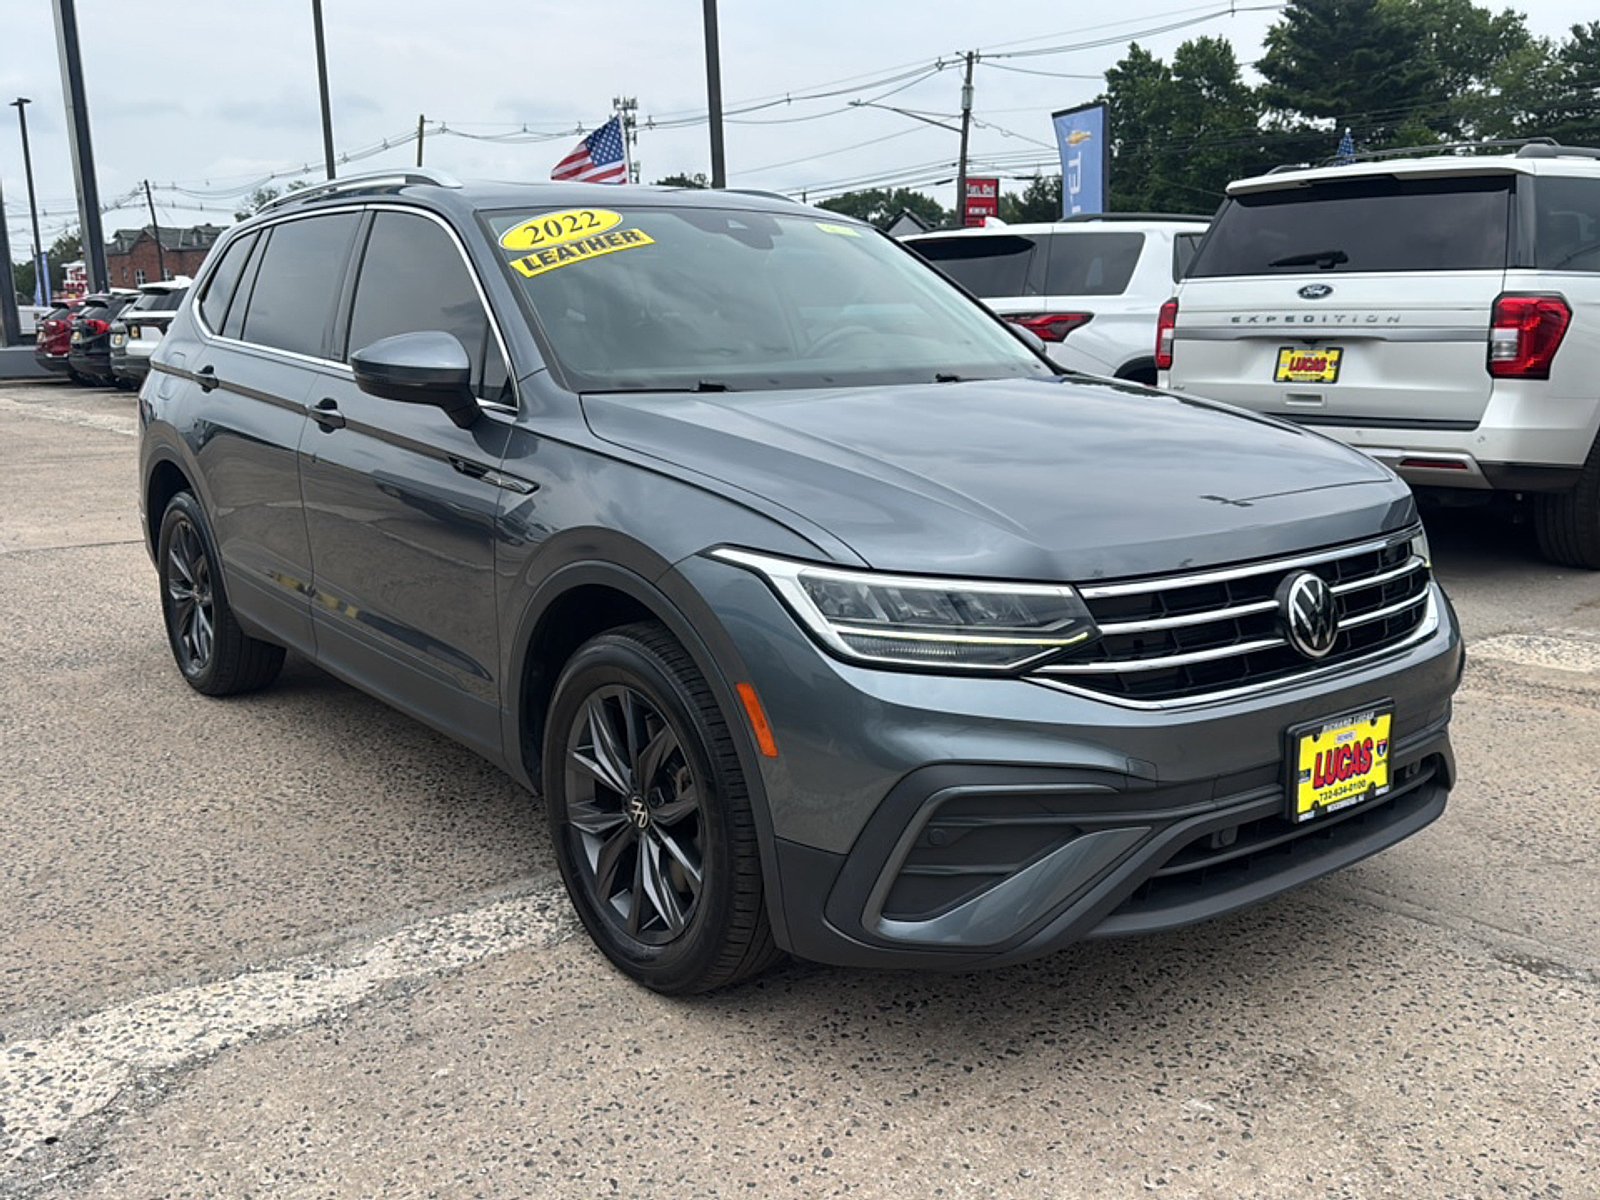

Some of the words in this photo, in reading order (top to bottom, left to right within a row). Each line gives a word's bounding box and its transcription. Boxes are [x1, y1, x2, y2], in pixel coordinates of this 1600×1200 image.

[523, 211, 601, 244] 2022
[521, 231, 641, 271] LEATHER
[1231, 314, 1402, 324] EXPEDITION
[1288, 356, 1329, 374] LUCAS
[1313, 737, 1373, 790] LUCAS
